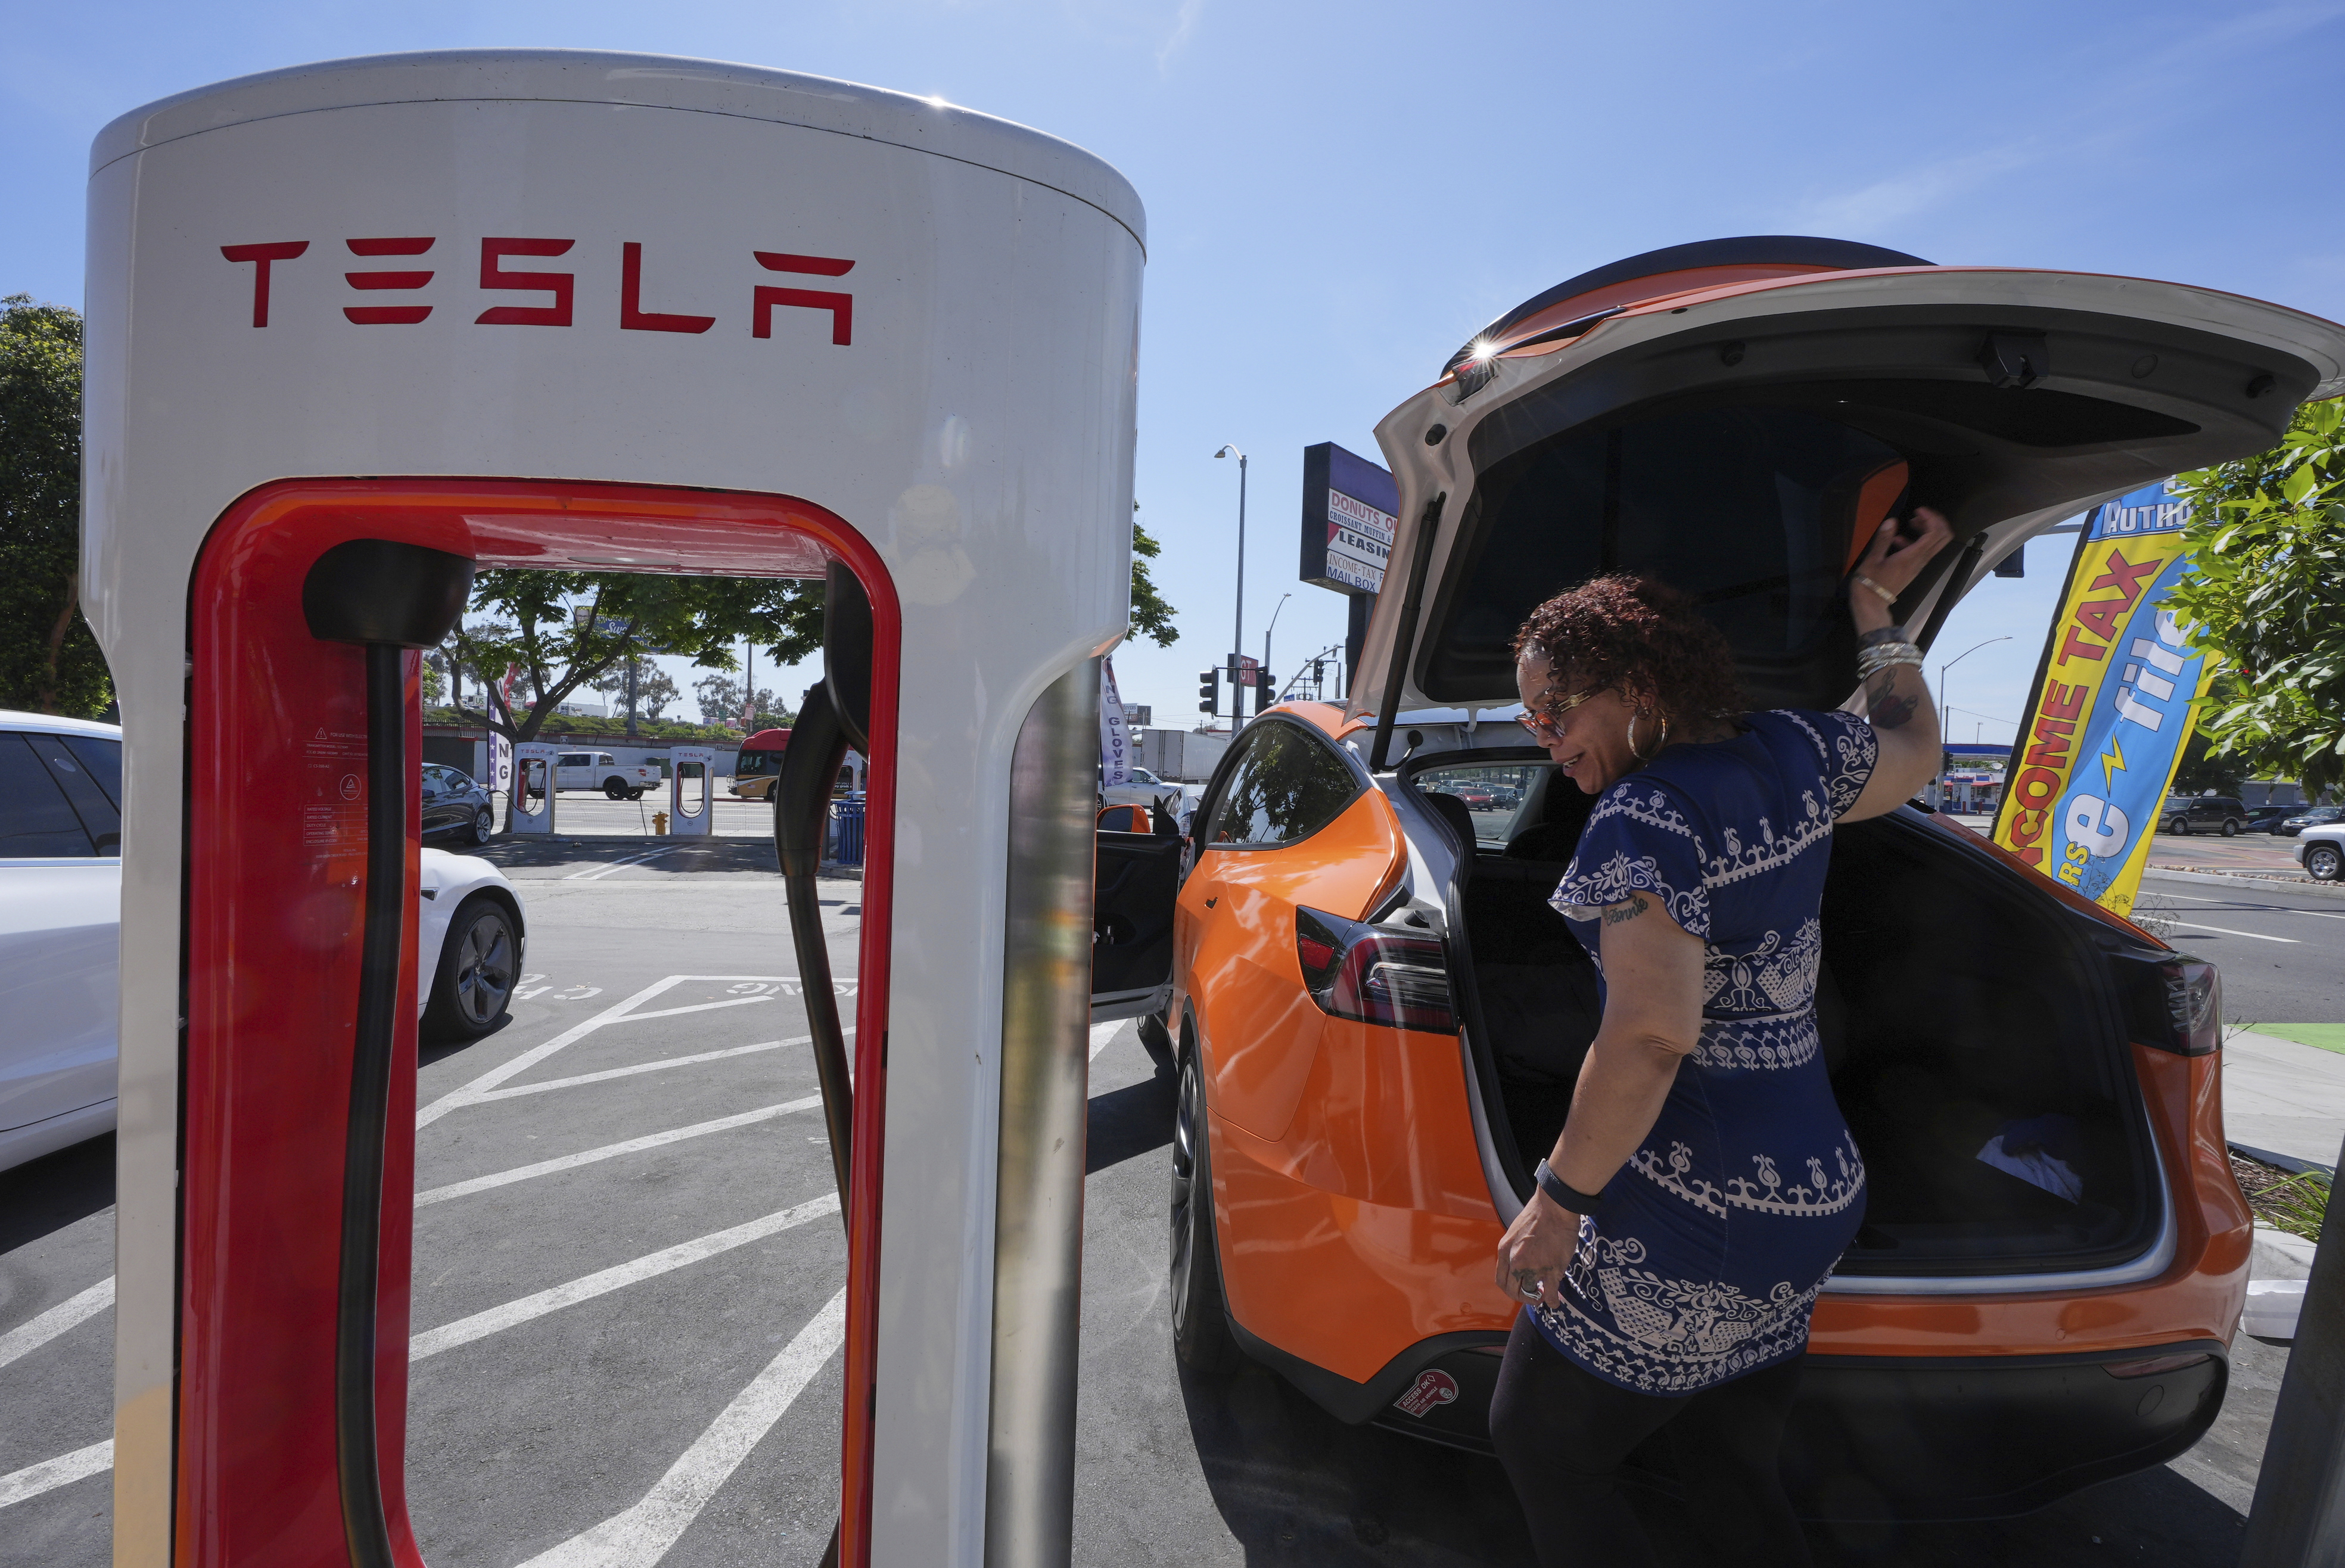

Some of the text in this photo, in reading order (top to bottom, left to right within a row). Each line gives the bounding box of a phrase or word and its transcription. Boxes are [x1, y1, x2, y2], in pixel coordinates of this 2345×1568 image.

[220, 237, 856, 346] TESLA
[1332, 492, 1380, 524] DONUTS
[1330, 511, 1362, 530] CROISSANT
[1364, 525, 1385, 540] MUFFIN
[1327, 567, 1376, 592] MAIL BOX
[2057, 548, 2164, 670] TAX
[1109, 717, 1123, 780] GLOVES
[1402, 1379, 1430, 1407] ACCESS OK
[1410, 1402, 1421, 1413] CLEAN
[1425, 1386, 1438, 1399] VEHICLE
